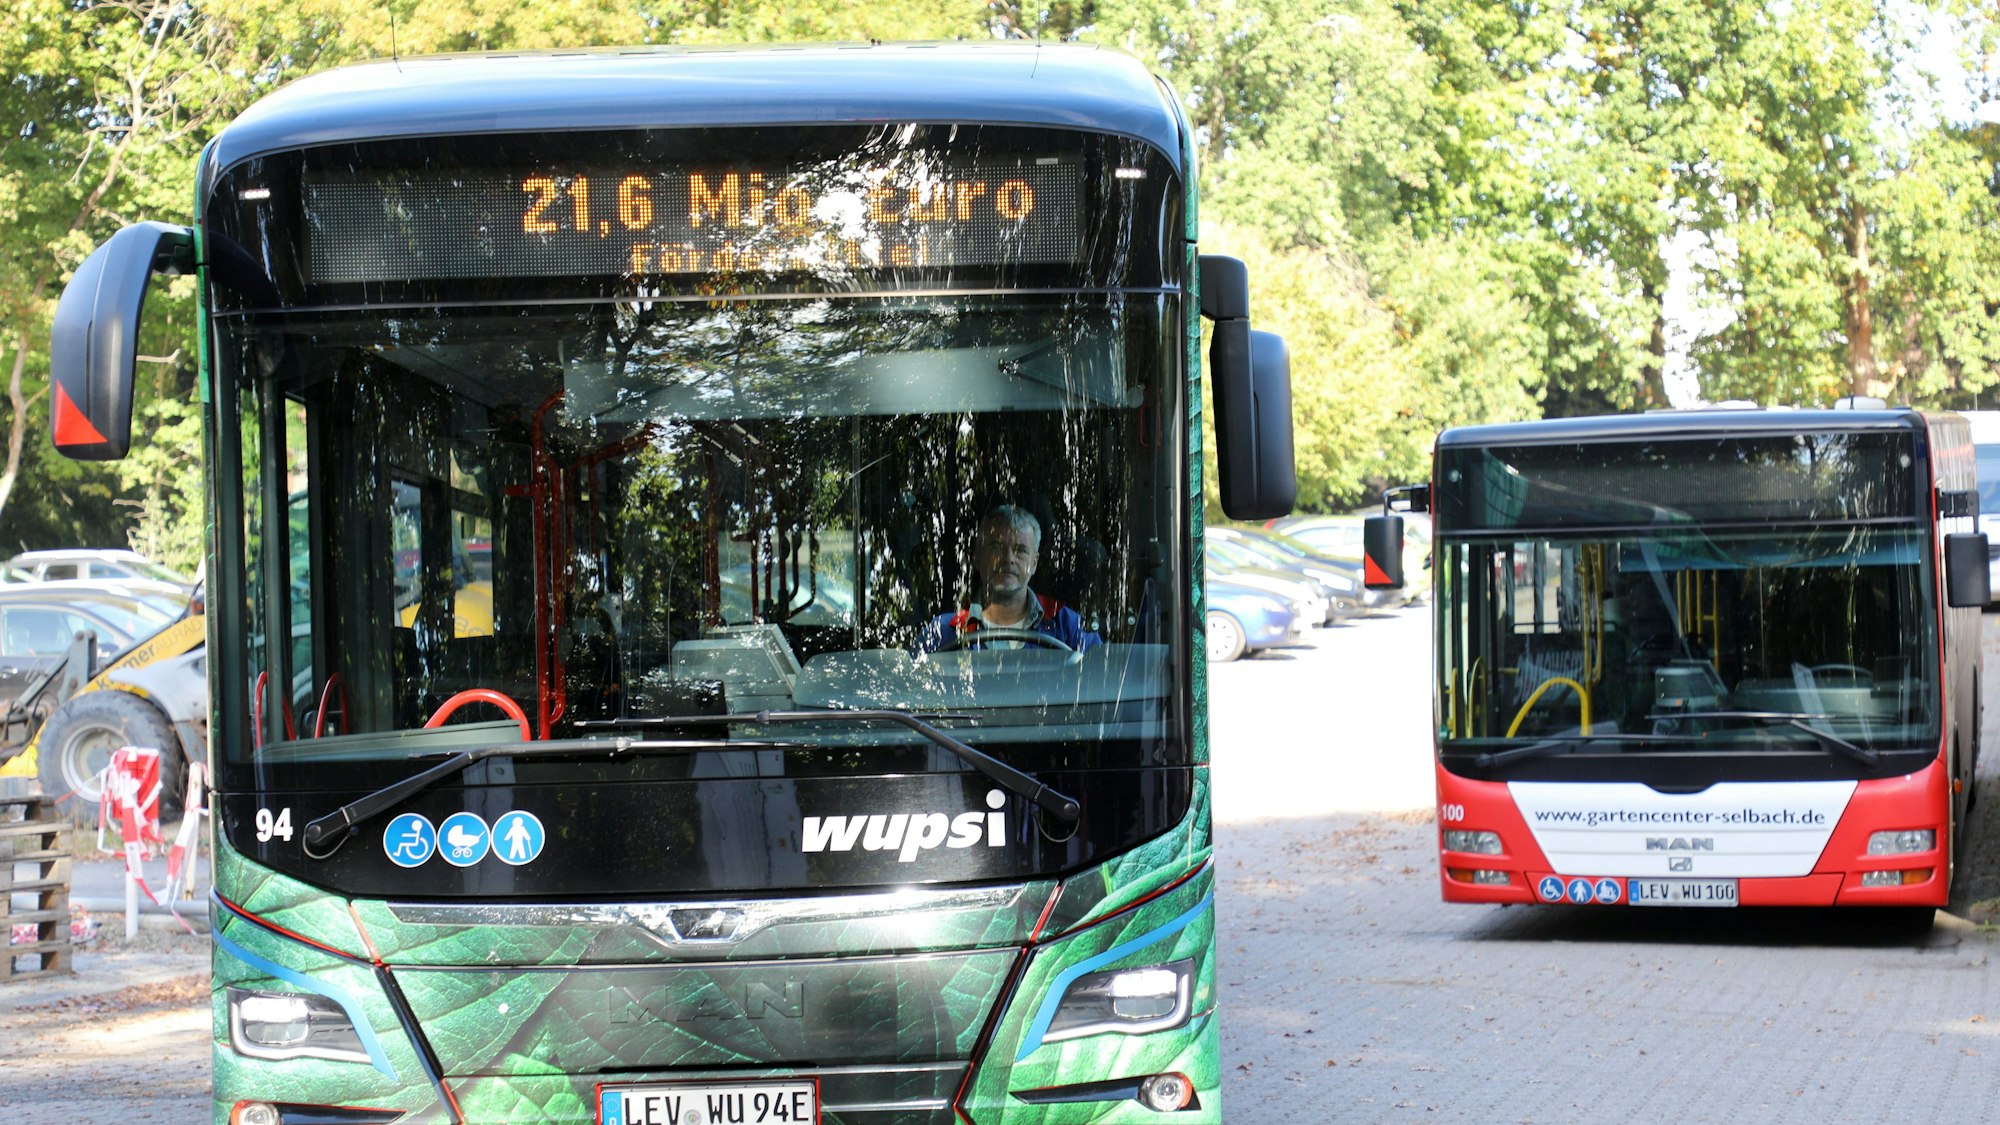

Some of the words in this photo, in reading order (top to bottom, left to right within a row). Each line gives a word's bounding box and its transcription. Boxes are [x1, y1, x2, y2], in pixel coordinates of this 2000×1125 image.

[522, 176, 652, 239] 21,6
[868, 169, 1034, 223] Euro
[632, 234, 930, 274] Fördeitel
[255, 807, 294, 843] 94
[801, 788, 1006, 863] wupsi
[1442, 804, 1464, 822] 100
[1535, 809, 1826, 826] www.gartencenter-selbach.de
[1646, 837, 1714, 851] MAN
[1640, 883, 1669, 899] LEV
[1682, 883, 1701, 899] WU
[1706, 884, 1735, 900] 100
[609, 981, 805, 1024] MAN
[624, 1095, 682, 1125] LEV
[707, 1093, 745, 1125] WU
[753, 1091, 809, 1123] 94E
